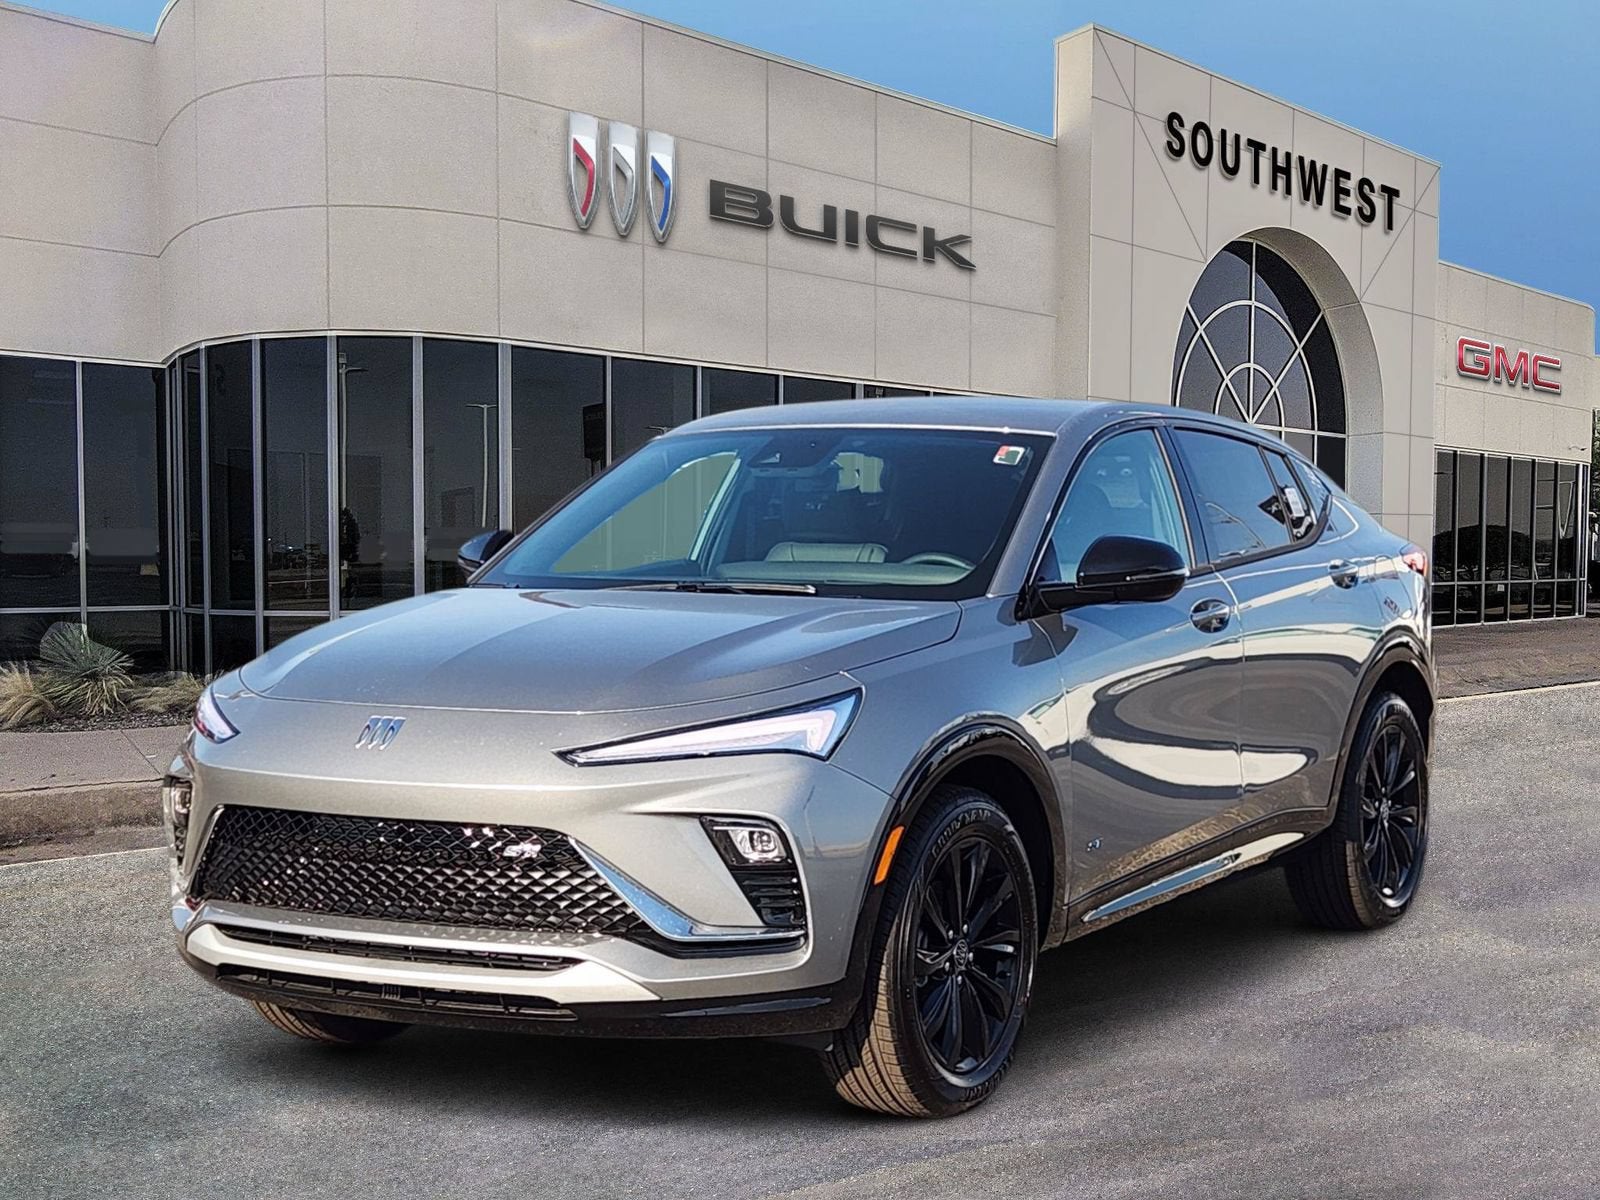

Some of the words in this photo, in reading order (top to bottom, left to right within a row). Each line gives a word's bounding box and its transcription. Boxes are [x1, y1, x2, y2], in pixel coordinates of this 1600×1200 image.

[1165, 111, 1400, 232] SOUTHWEST
[708, 178, 977, 271] BUICK
[1457, 335, 1562, 394] GMC
